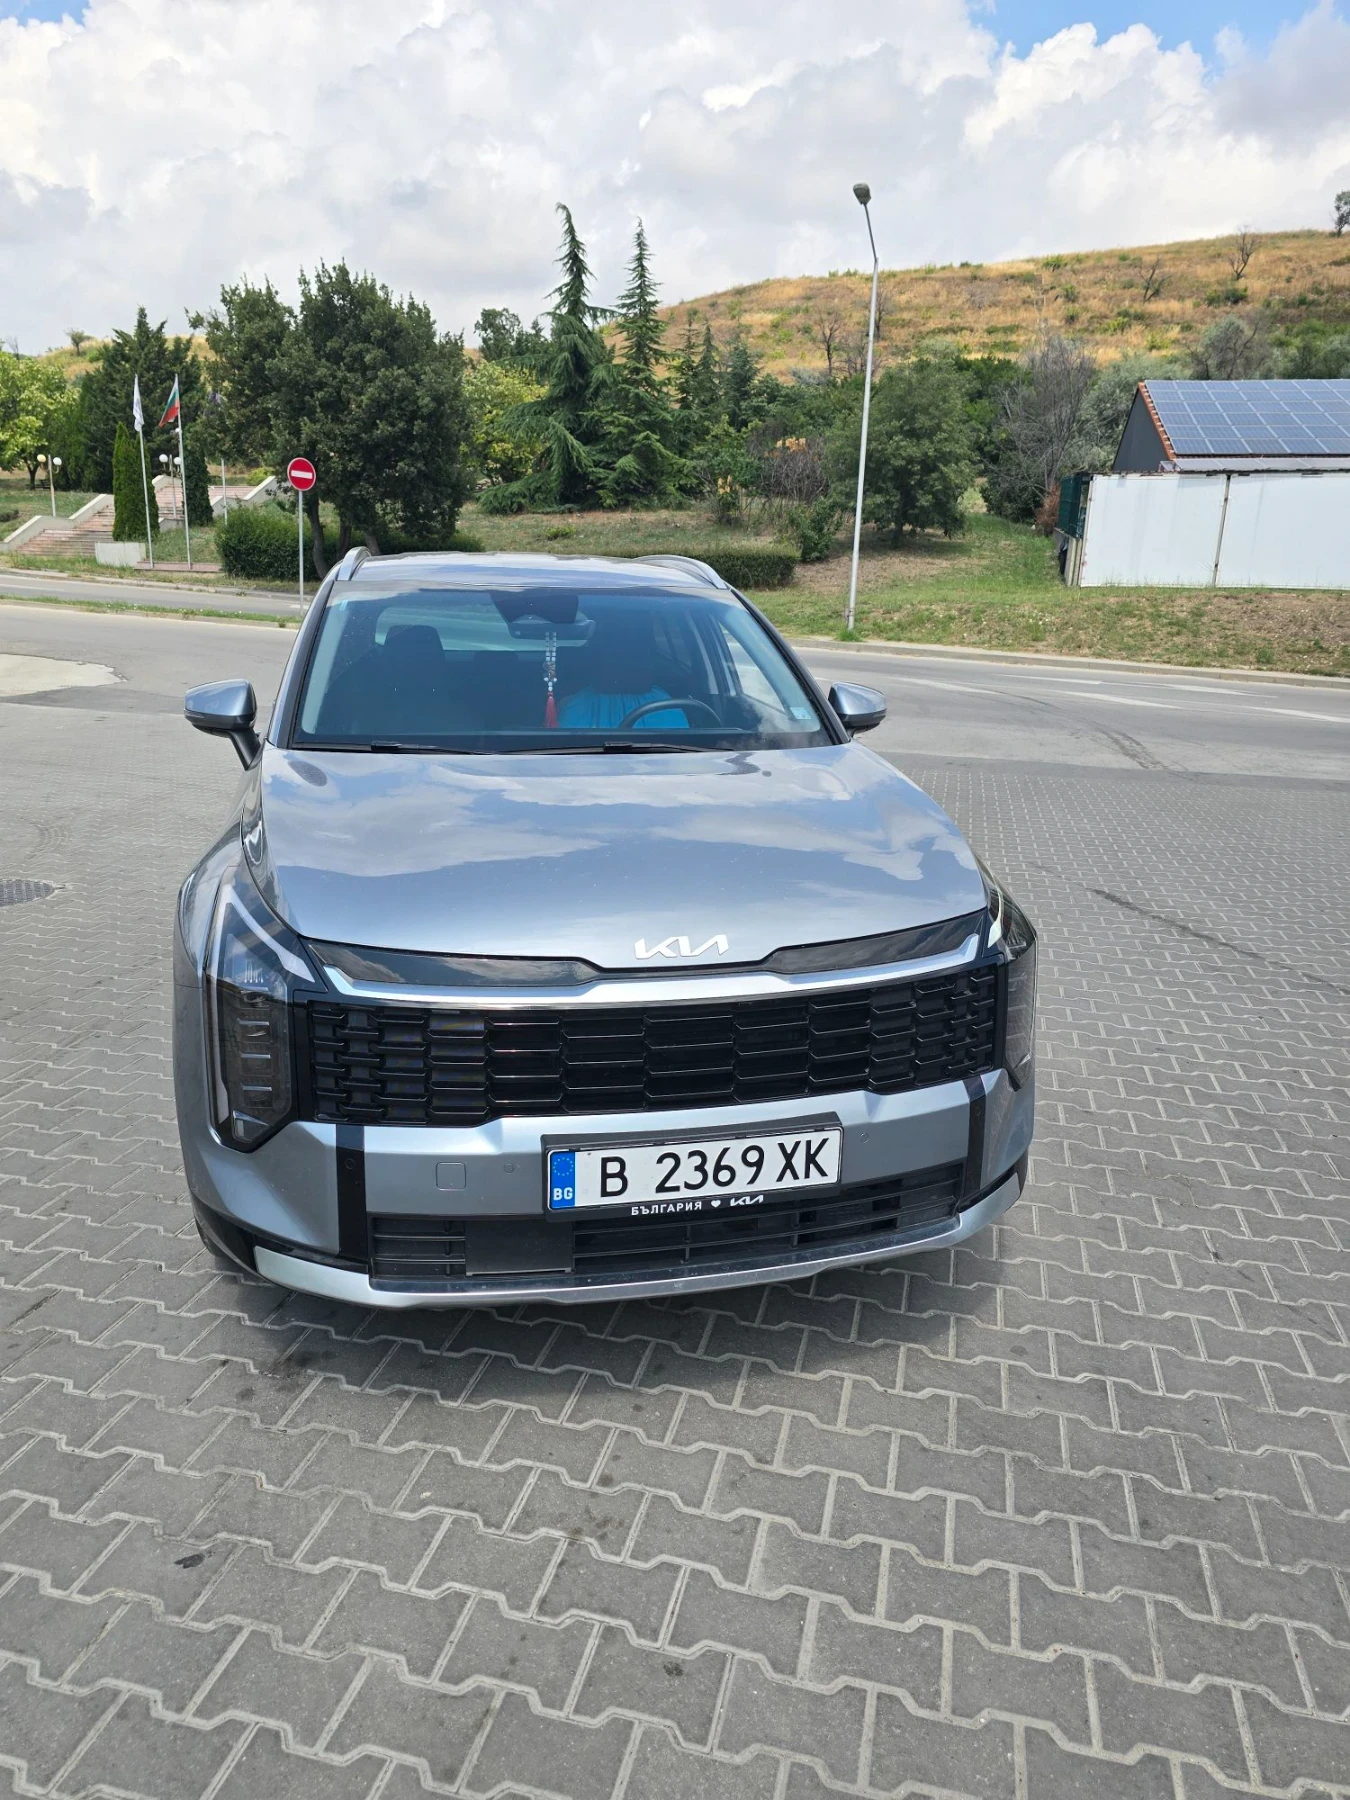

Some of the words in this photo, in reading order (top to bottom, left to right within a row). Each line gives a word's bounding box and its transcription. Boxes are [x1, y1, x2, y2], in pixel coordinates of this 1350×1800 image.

[634, 934, 729, 960] KIA
[600, 1156, 628, 1198] B
[655, 1144, 764, 1194] 2369
[776, 1137, 830, 1182] XK
[553, 1187, 573, 1201] BG
[631, 1201, 702, 1216] БЪЛГАРИЯ
[730, 1194, 764, 1207] KIA
